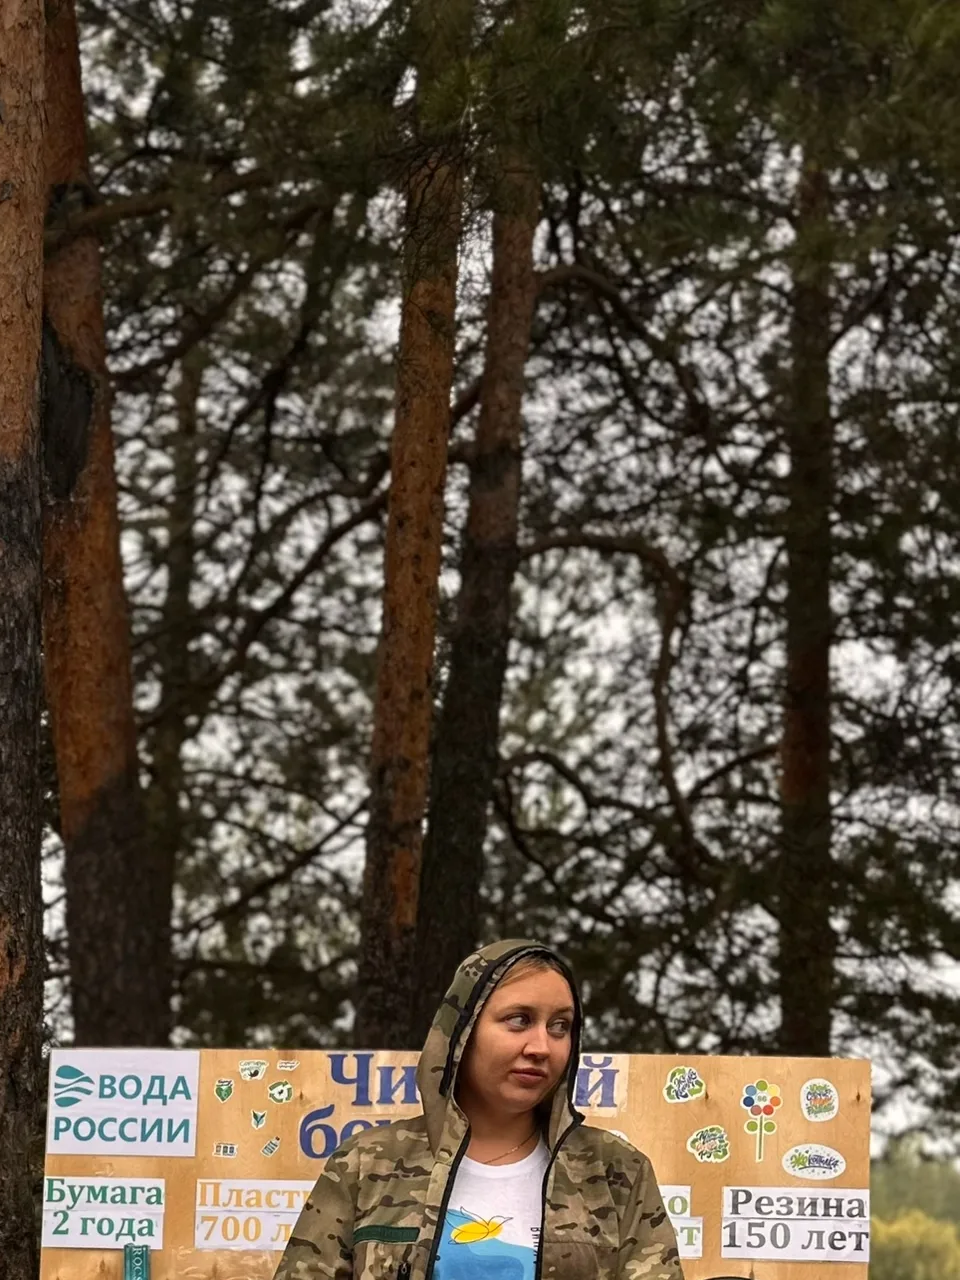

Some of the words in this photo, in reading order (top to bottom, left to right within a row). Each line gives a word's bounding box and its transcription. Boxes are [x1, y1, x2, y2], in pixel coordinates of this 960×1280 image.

[99, 1074, 192, 1102] ВОДА
[53, 1116, 190, 1143] РОССИИ
[46, 1178, 163, 1210] Бумага
[730, 1189, 867, 1218] Резина
[52, 1211, 70, 1236] 2
[80, 1216, 155, 1242] года
[201, 1216, 262, 1242] 700
[722, 1222, 790, 1251] 150
[801, 1225, 869, 1252] лет
